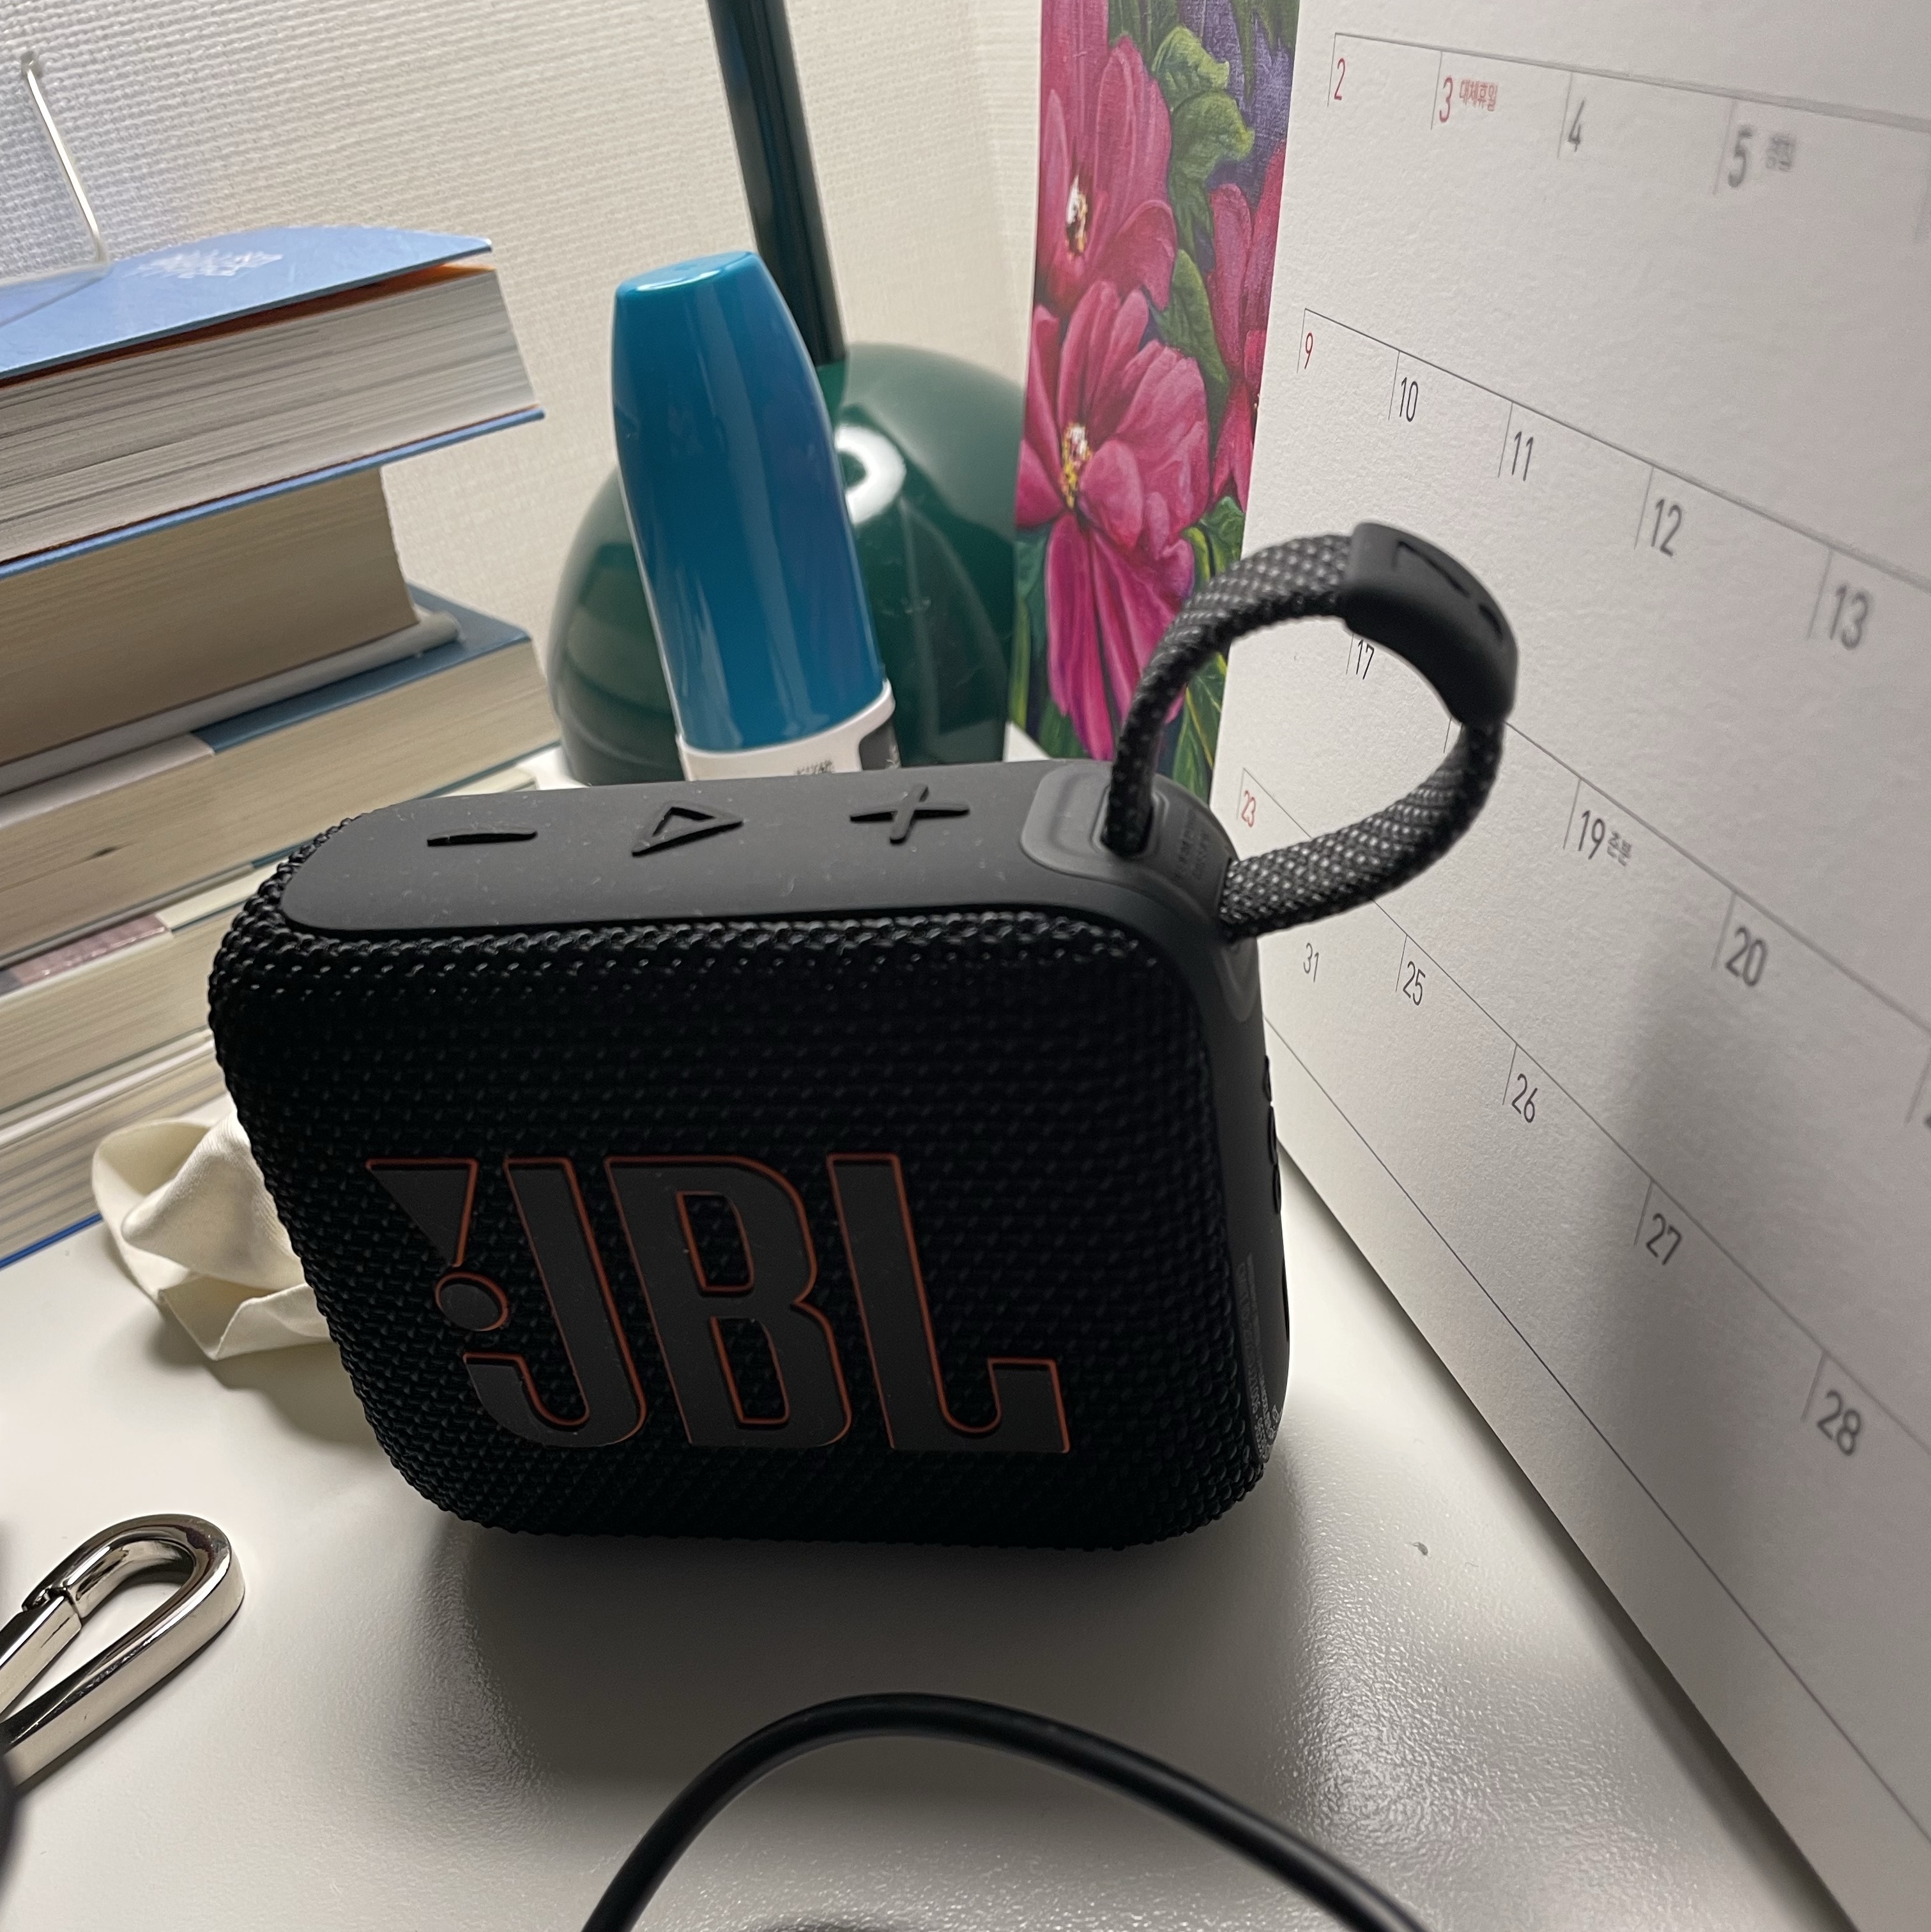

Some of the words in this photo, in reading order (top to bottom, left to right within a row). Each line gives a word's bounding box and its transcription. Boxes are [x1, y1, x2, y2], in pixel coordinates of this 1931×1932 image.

[1333, 57, 1346, 101] 2
[1439, 76, 1453, 123] 3
[1459, 79, 1498, 112] 대체휴일
[1568, 100, 1584, 151] 4
[1727, 125, 1753, 188] 5
[1304, 332, 1313, 369] 9
[1399, 377, 1418, 422] 10
[1511, 431, 1534, 482] 11
[1651, 498, 1683, 558] 12
[1829, 583, 1871, 650] 13
[1355, 639, 1375, 680] 17
[1241, 790, 1256, 828] 23
[1578, 810, 1606, 860] 19
[1303, 942, 1320, 983] 31
[1725, 925, 1768, 987] 20
[1403, 961, 1426, 1006] 25
[1511, 1073, 1538, 1123] 26
[1645, 1213, 1683, 1266] 27
[1816, 1389, 1863, 1457] 28
